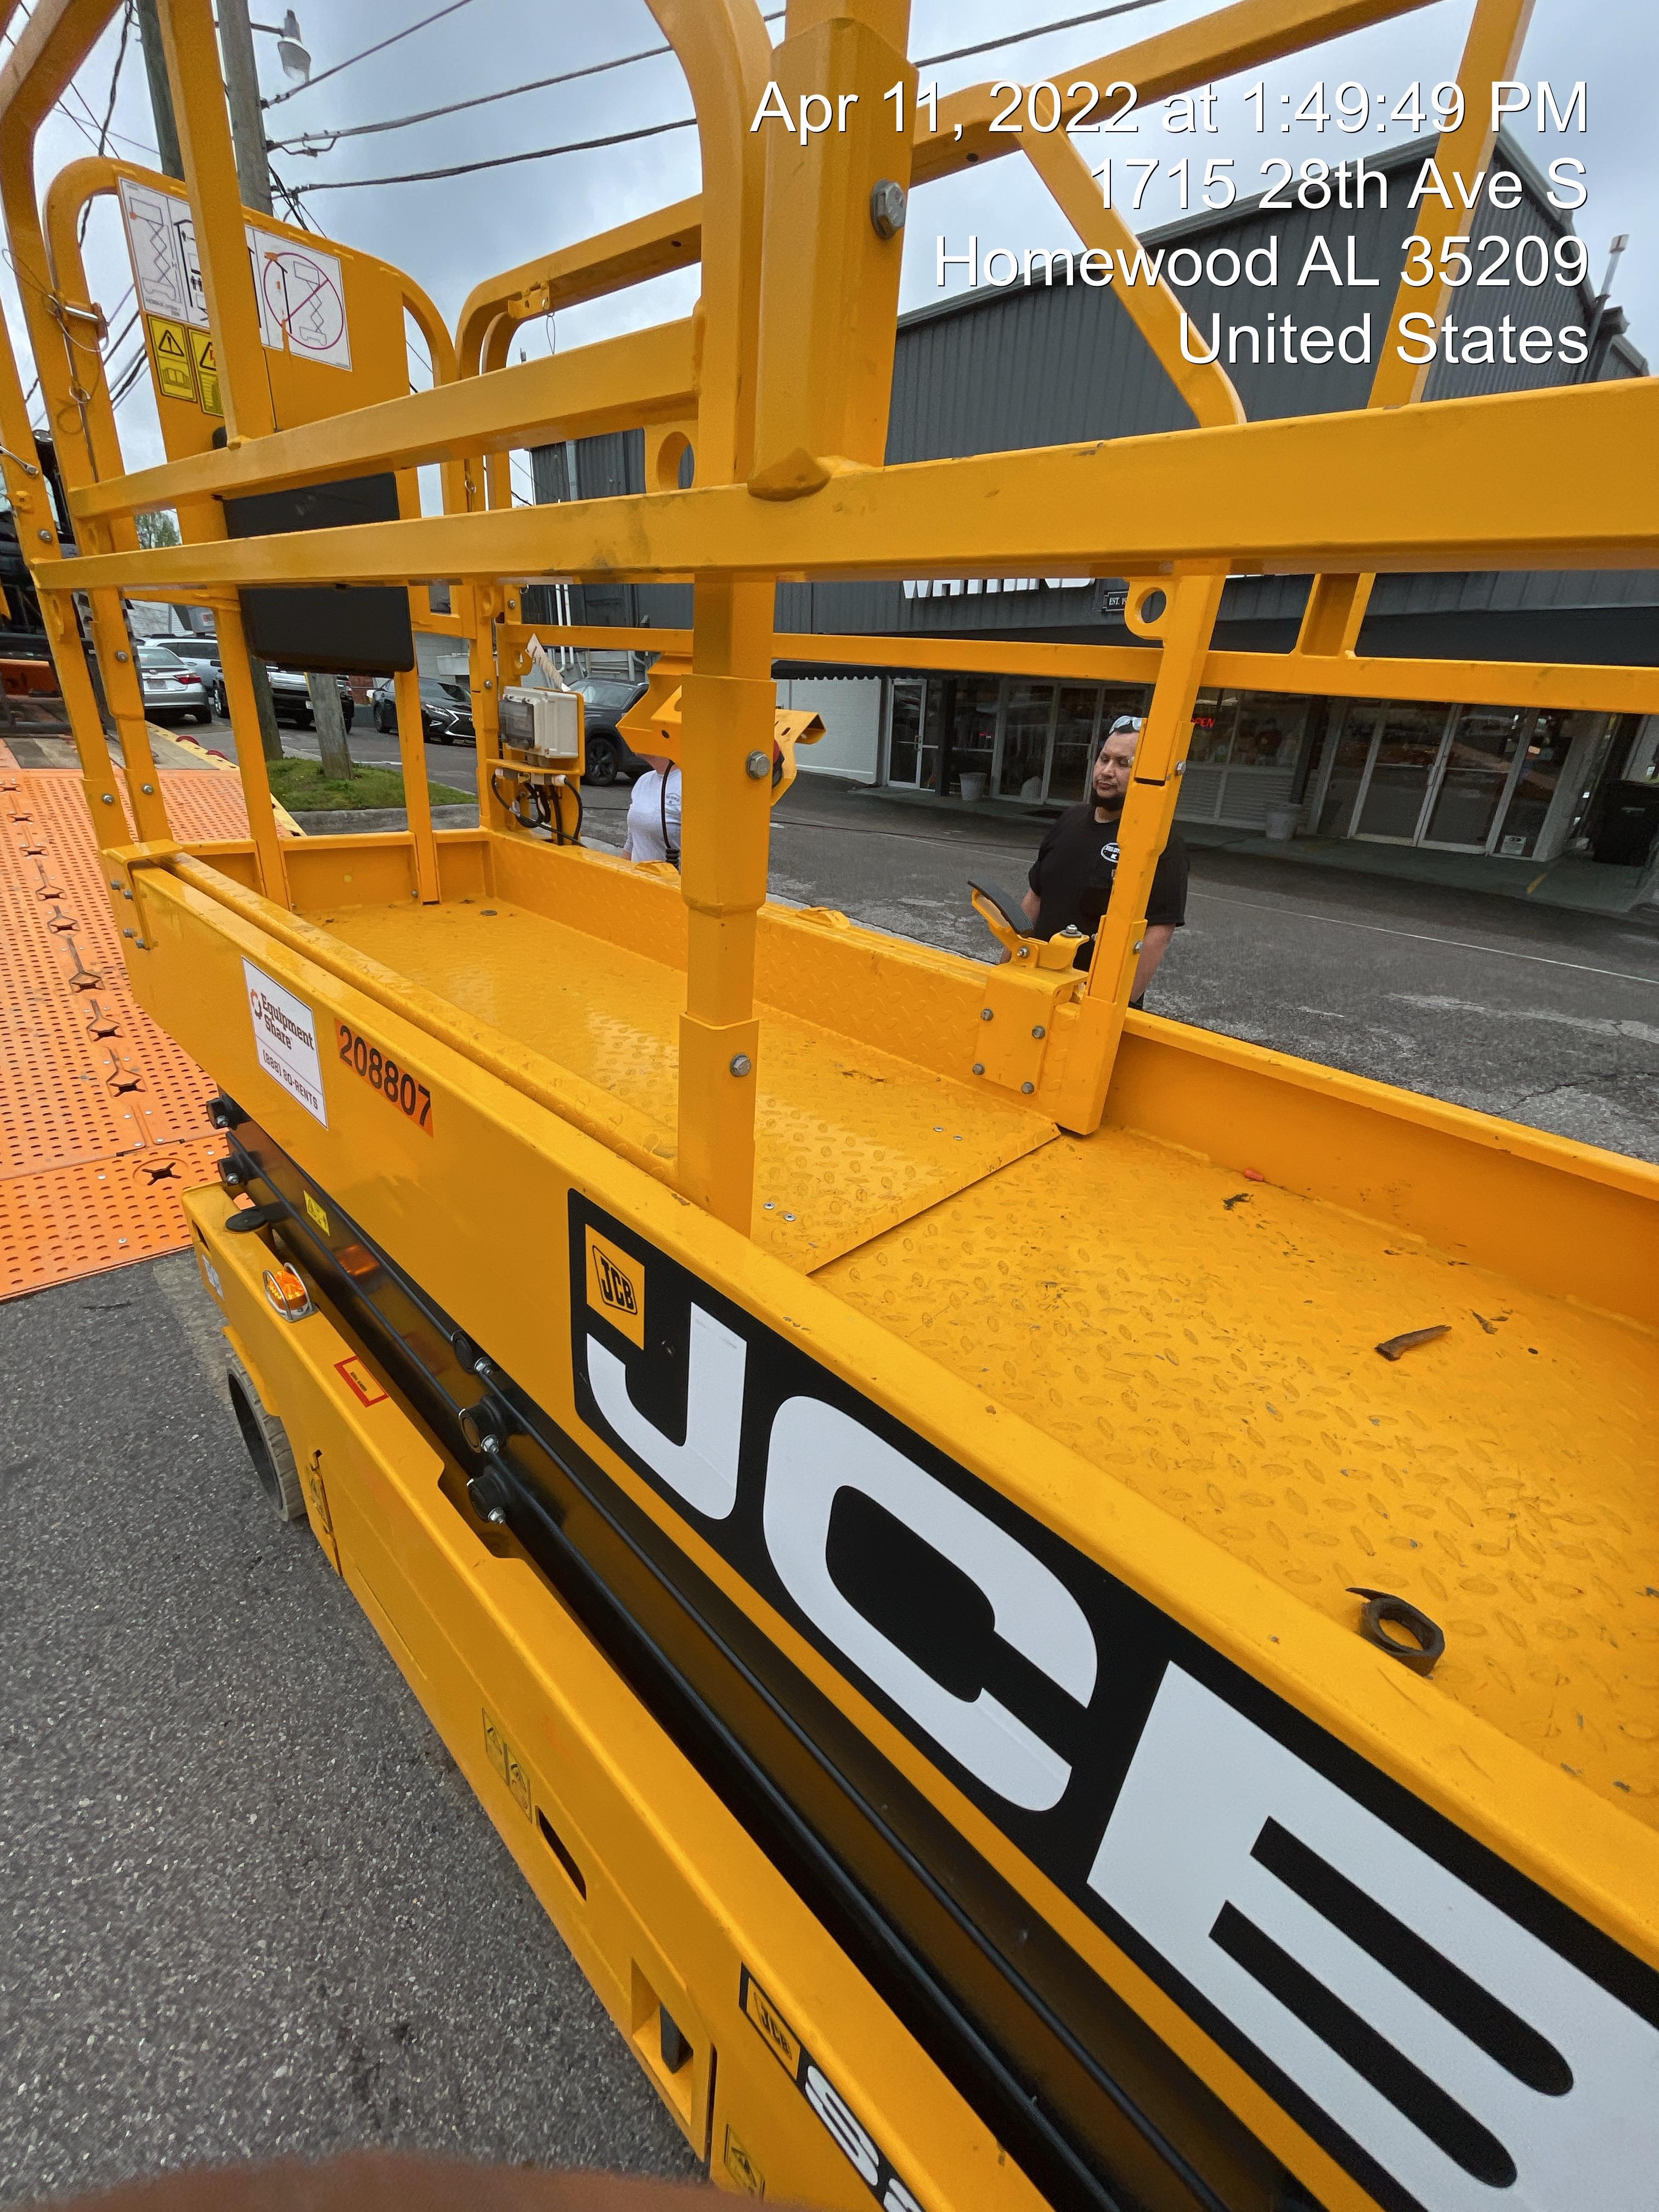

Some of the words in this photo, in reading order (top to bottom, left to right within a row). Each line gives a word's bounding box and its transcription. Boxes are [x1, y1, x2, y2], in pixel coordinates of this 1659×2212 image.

[1109, 597, 1120, 605] EST.
[1192, 717, 1216, 727] PEN
[261, 992, 315, 1051] Equipment
[264, 1014, 292, 1050] Share
[262, 1049, 282, 1076] (888)
[283, 1069, 318, 1110] 80-RENTS
[338, 1025, 432, 1127] 208807
[600, 1256, 634, 1310] JCB
